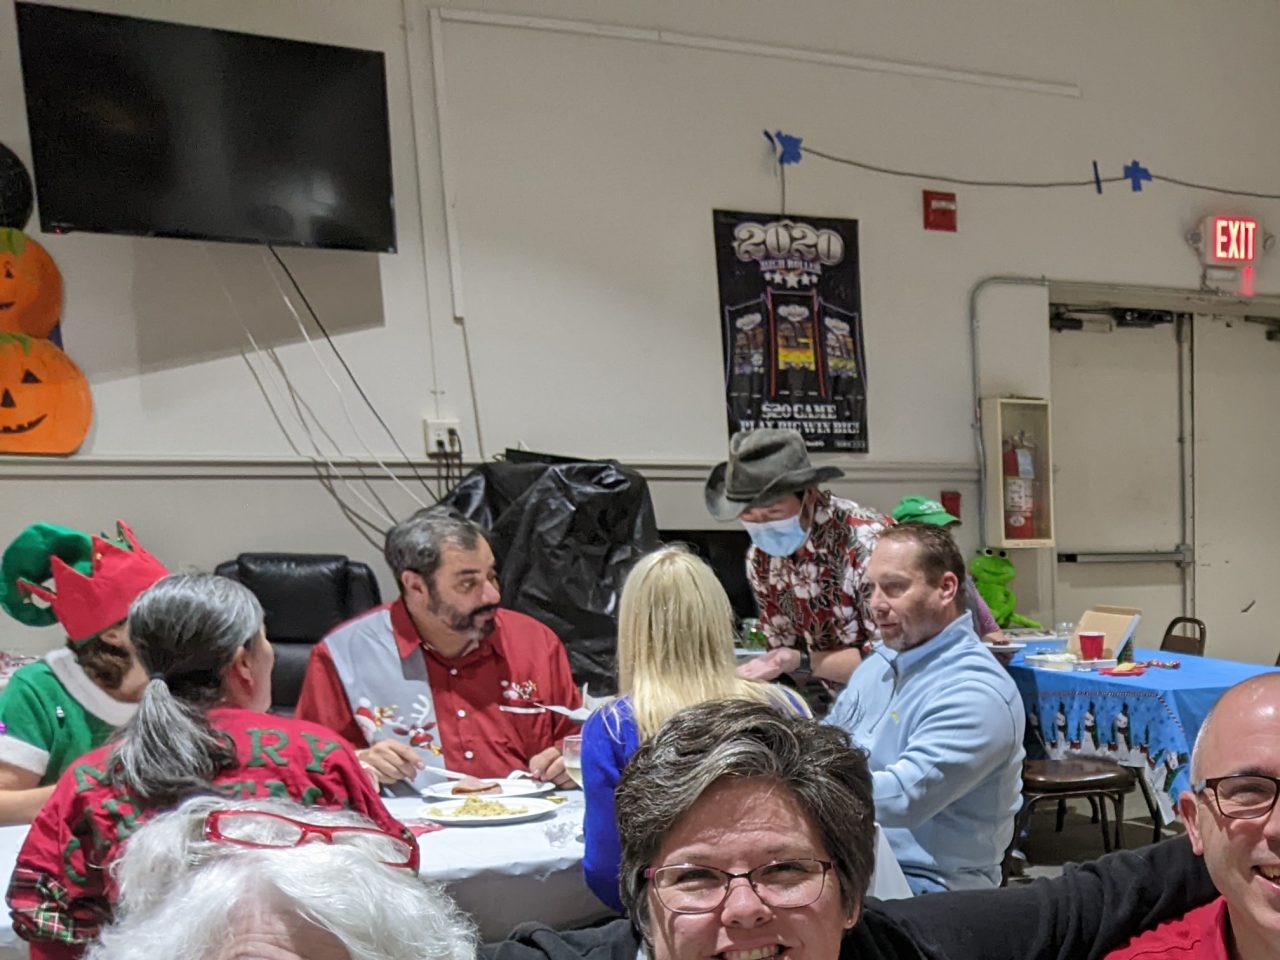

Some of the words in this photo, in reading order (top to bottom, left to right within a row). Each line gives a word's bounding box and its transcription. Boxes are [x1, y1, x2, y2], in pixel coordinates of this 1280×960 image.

[736, 222, 844, 266] 2020
[1215, 218, 1257, 261] EXIT
[762, 402, 792, 420] $20
[793, 404, 837, 419] GAME
[802, 421, 832, 434] WIN
[833, 421, 860, 434] BIG!
